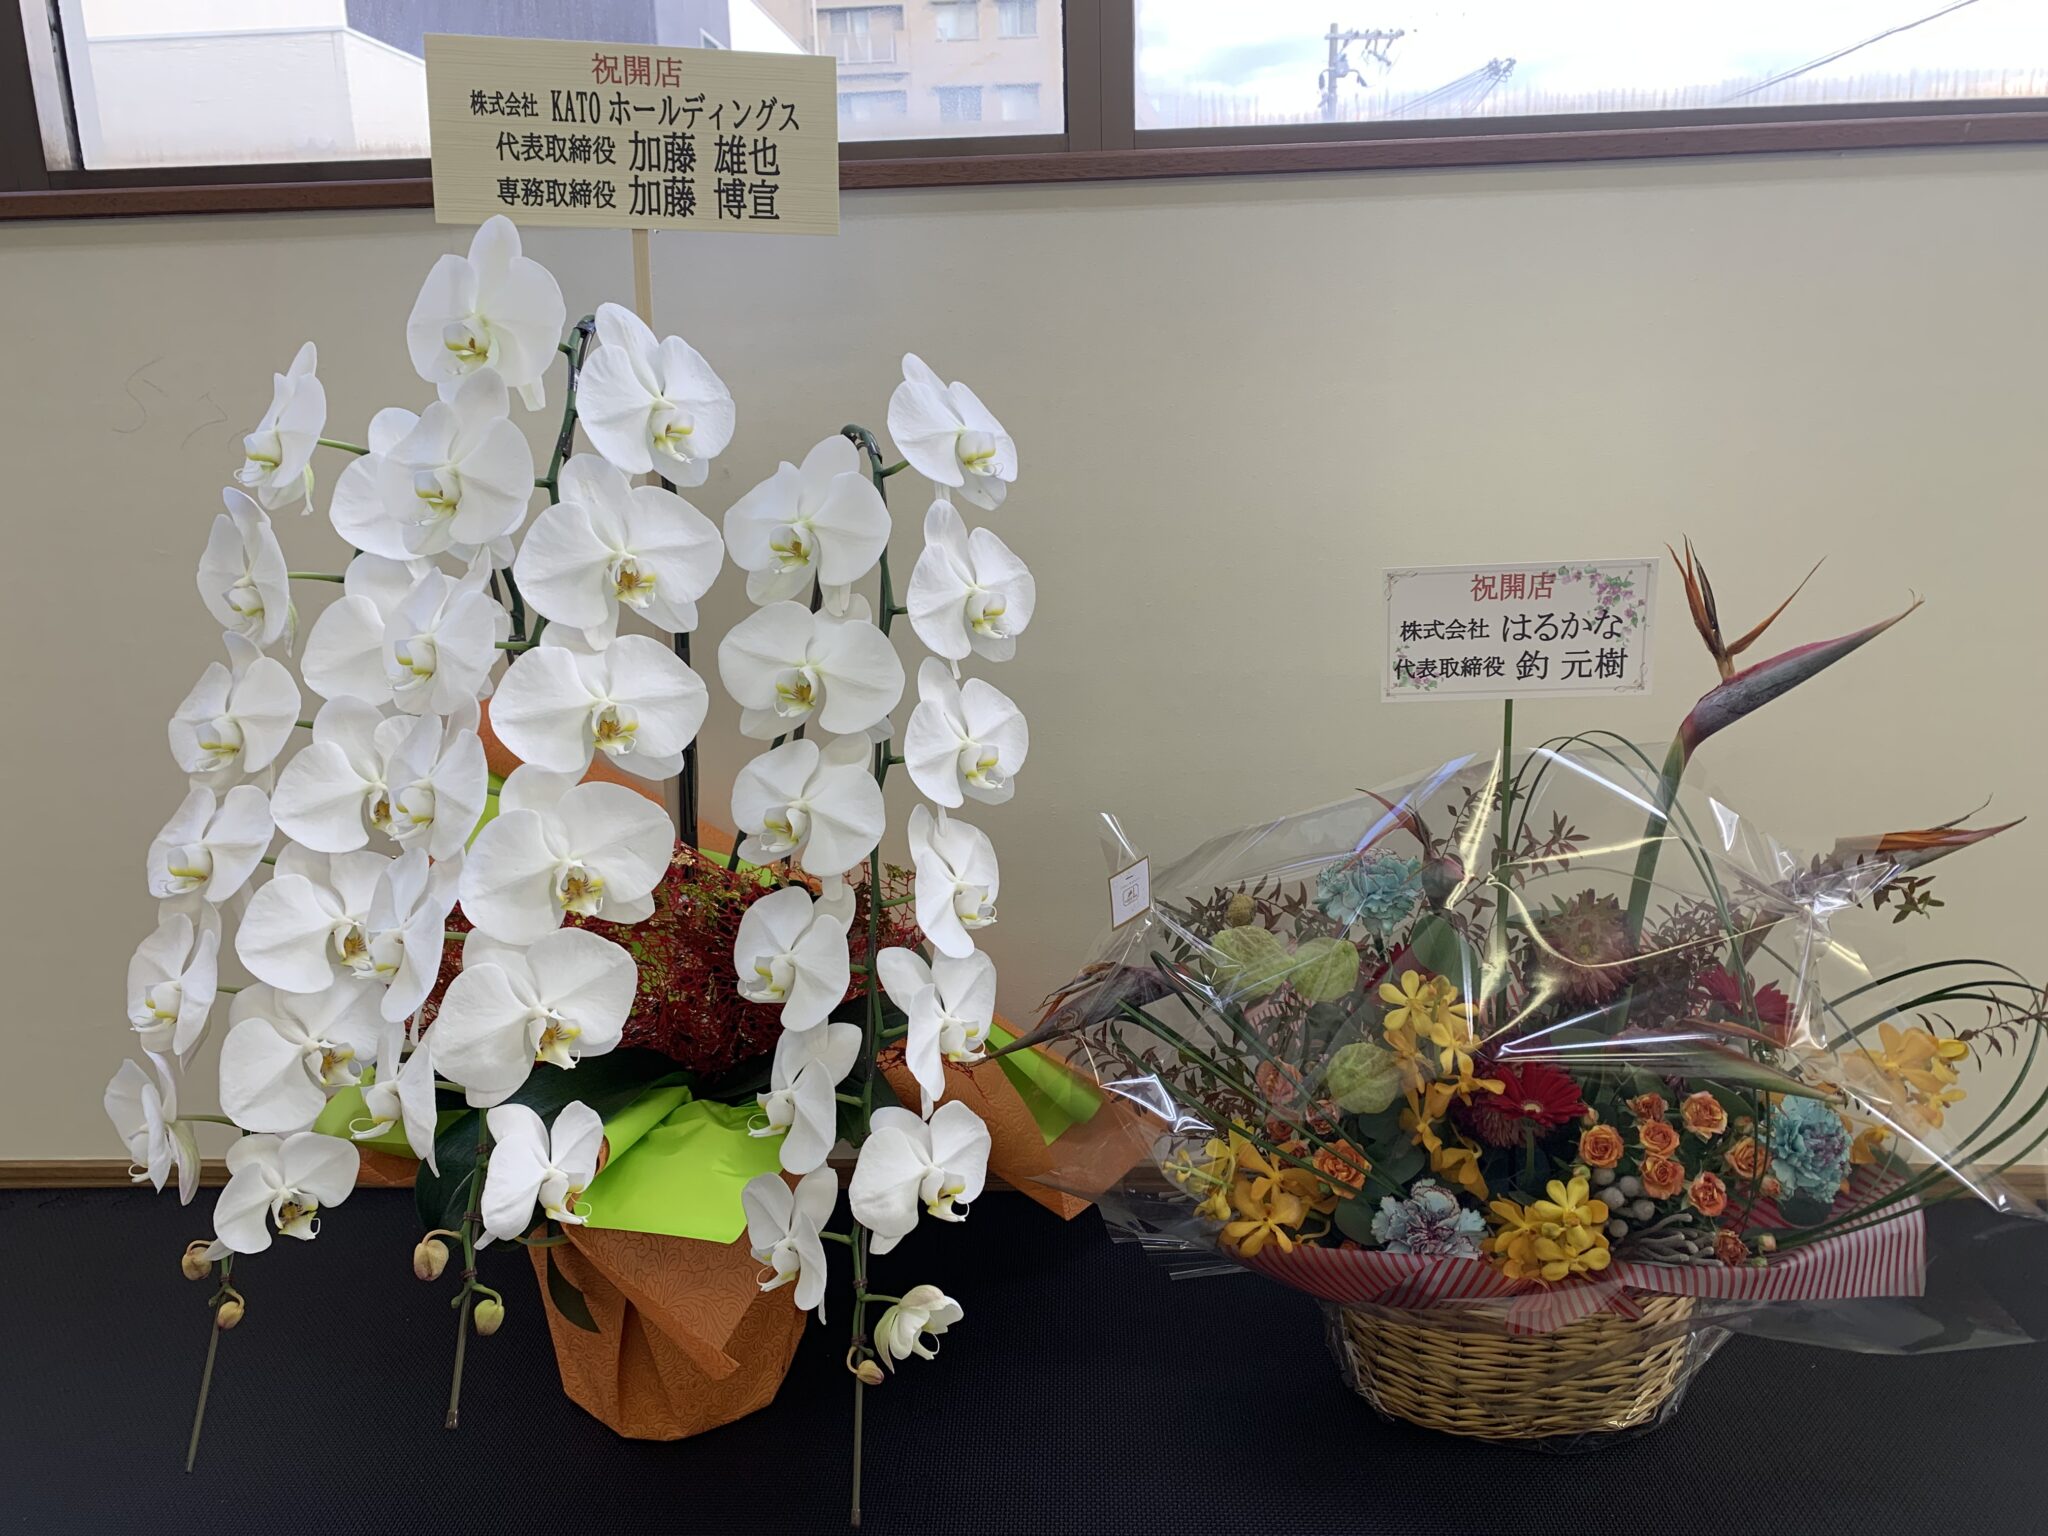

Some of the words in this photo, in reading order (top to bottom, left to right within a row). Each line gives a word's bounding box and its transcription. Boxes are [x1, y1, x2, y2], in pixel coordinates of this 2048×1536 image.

[592, 53, 682, 87] 祝開店
[470, 90, 539, 117] 株式会社
[551, 90, 600, 124] KATO
[609, 91, 799, 131] ホールディングス
[496, 131, 616, 164] 代表取締役
[628, 130, 696, 174] 加藤
[714, 134, 780, 176] 雄也
[497, 177, 616, 208] 専務取締役
[629, 175, 696, 217] 加藤
[714, 178, 779, 219] 博宣
[1471, 573, 1554, 601] 祝開店
[1400, 618, 1490, 642] 株式会社
[1503, 610, 1623, 642] はるかな
[1393, 656, 1505, 680] 代表取締役
[1516, 650, 1549, 680] 釣
[1561, 648, 1628, 680] 元樹
